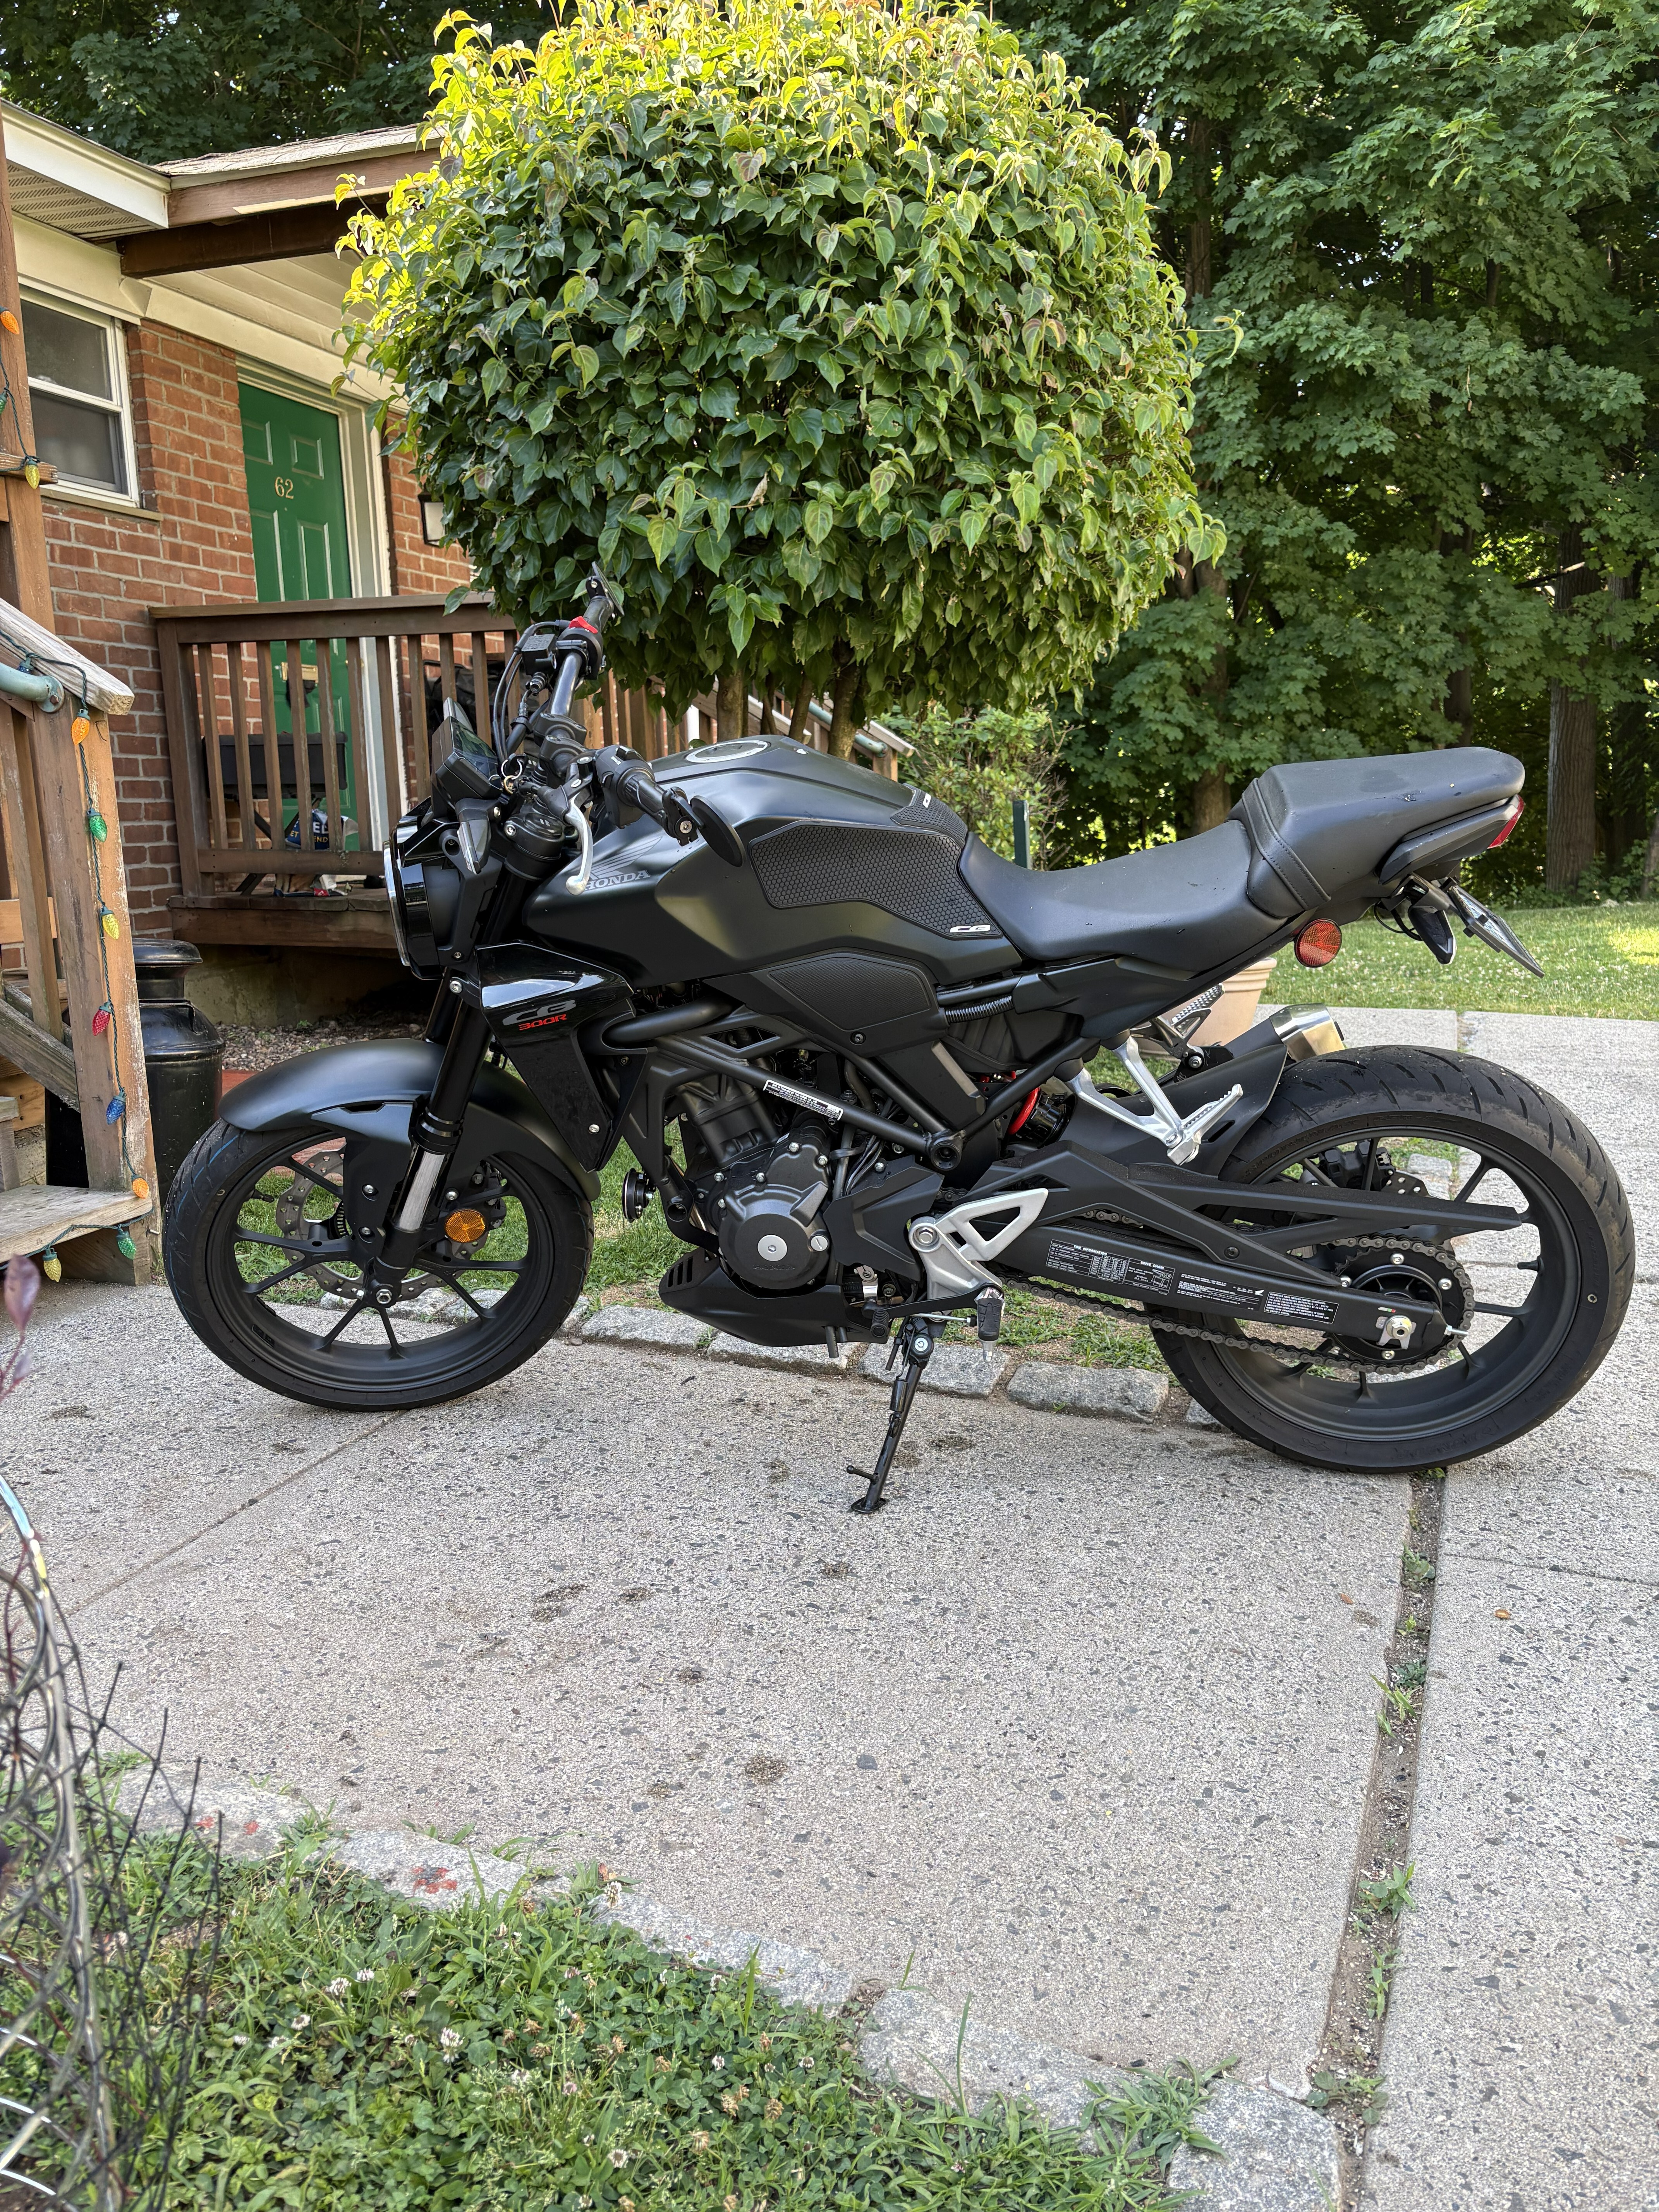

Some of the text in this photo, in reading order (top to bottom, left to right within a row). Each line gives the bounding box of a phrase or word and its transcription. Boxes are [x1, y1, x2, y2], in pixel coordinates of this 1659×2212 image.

[275, 477, 294, 499] 62
[585, 870, 651, 890] HONDA
[502, 1000, 576, 1025] CB
[519, 1014, 567, 1032] 300R
